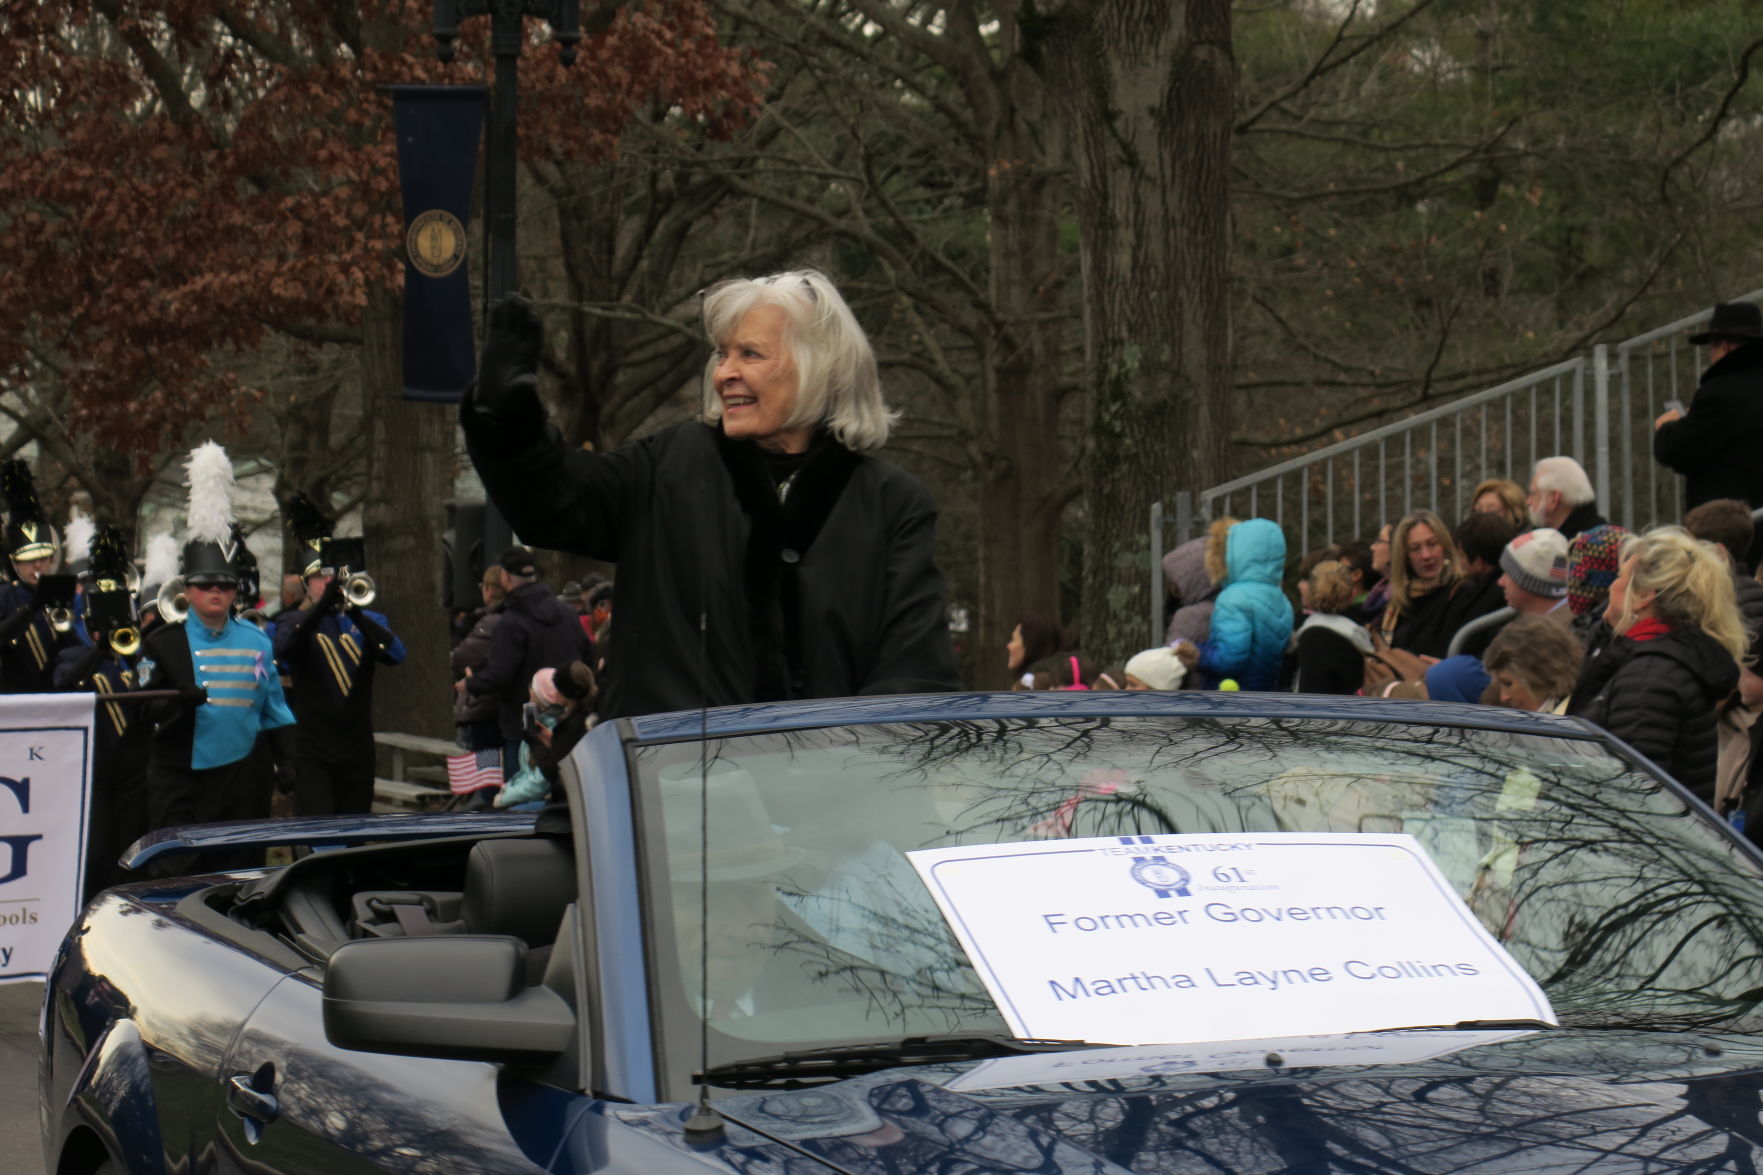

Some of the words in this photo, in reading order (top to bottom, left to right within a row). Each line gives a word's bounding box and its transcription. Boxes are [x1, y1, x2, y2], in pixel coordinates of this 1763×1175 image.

[27, 744, 46, 762] K
[1042, 909, 1190, 933] Former
[1204, 902, 1387, 923] Governor
[1048, 971, 1198, 1001] Martha
[1204, 966, 1334, 990] Layne
[1344, 960, 1480, 979] Collins
